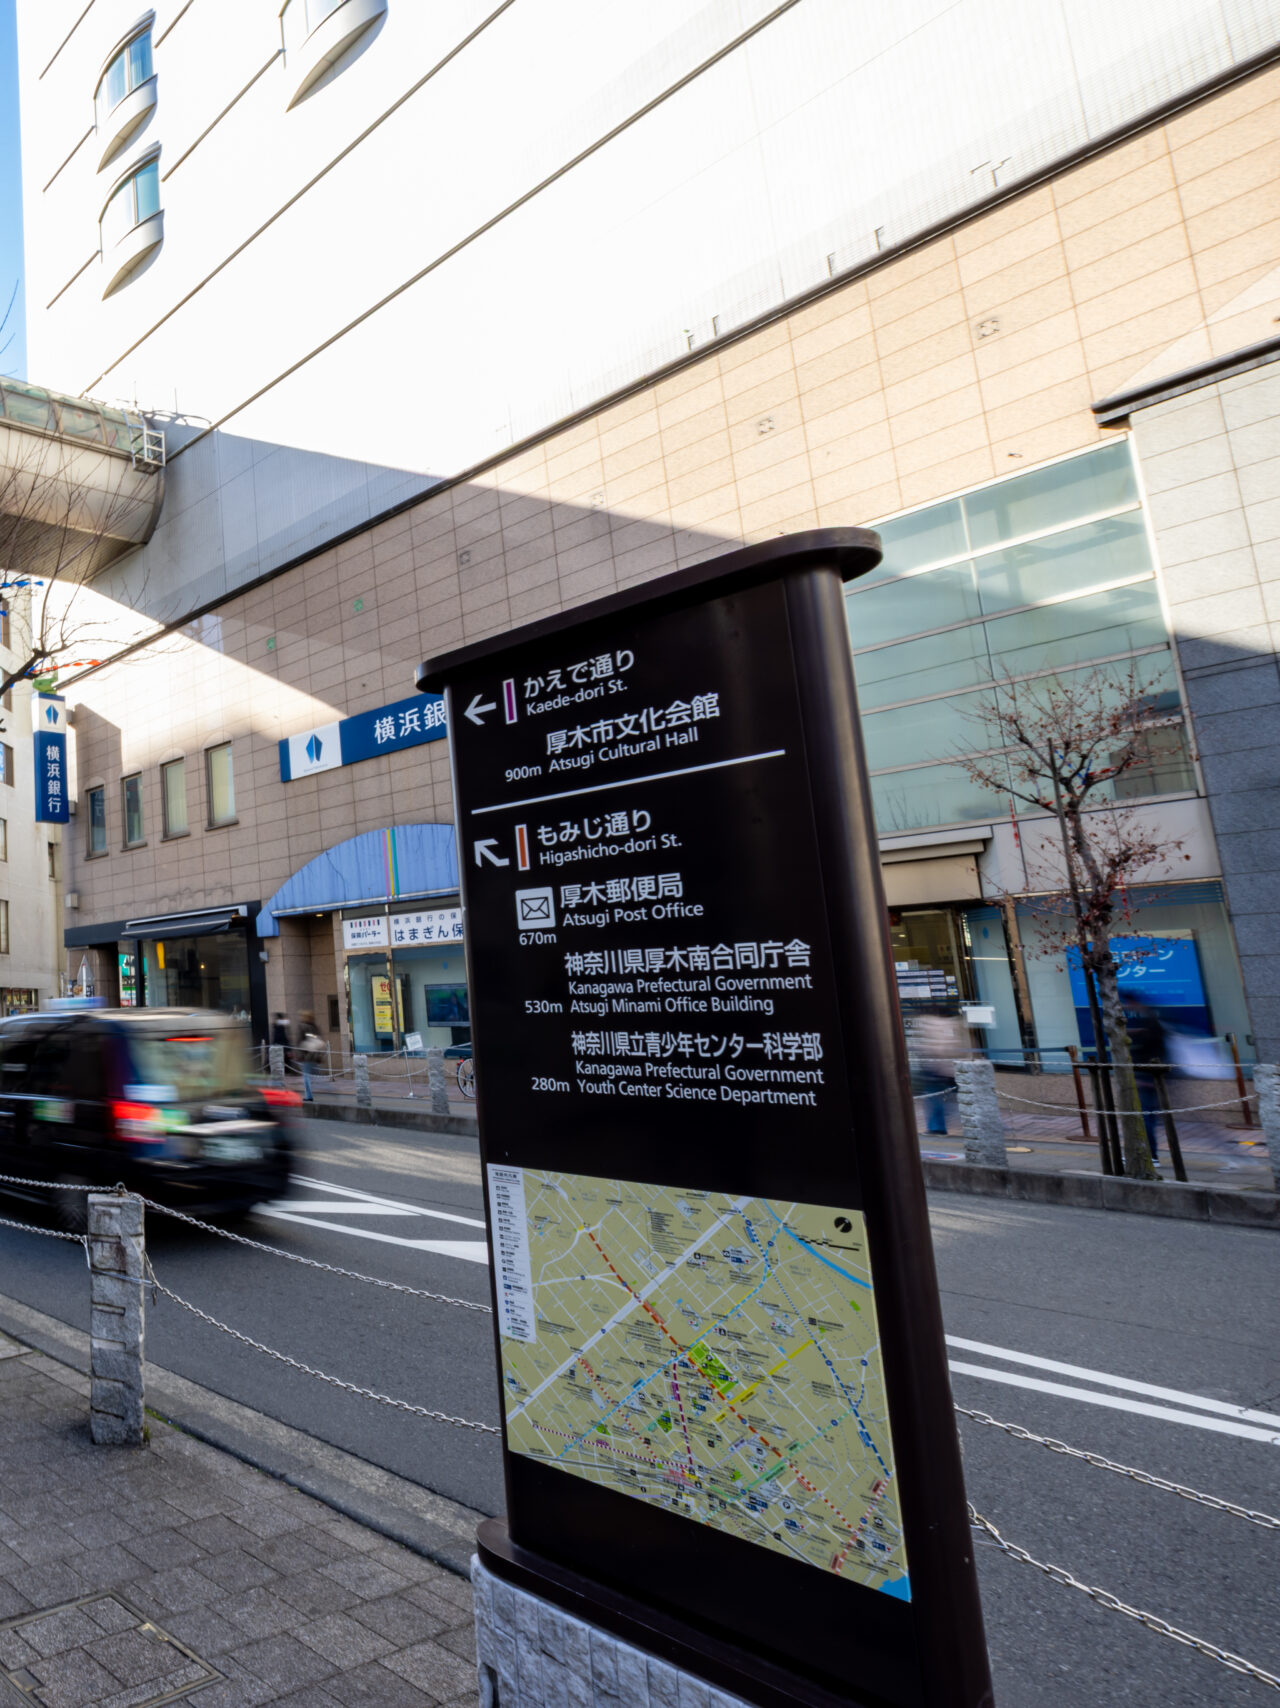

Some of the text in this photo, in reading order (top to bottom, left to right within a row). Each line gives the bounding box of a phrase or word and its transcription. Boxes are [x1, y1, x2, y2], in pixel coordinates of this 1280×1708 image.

[523, 650, 635, 699] かえで通り
[526, 679, 628, 716] Kaede-dori St.
[373, 699, 448, 745] 横浜銀
[546, 692, 721, 756] 厚木市文化会館
[505, 726, 699, 782] 900m Atsugi Cultural Hall
[46, 745, 61, 813] 横浜銀行
[537, 809, 651, 847] もみじ通り
[539, 834, 683, 867] Higashicho-dori St.
[560, 872, 683, 909] 厚木郵便局
[562, 901, 704, 928] Atsugi Post Office
[519, 931, 557, 946] 670m
[564, 938, 811, 977] 神奈川県厚木南合同庁舎
[568, 973, 813, 998] Kanagawa Prefectural Government
[525, 995, 774, 1017] 530m Atsugi Minami Office Building
[570, 1030, 824, 1062] 神奈川県立青少年センター科学部
[575, 1060, 825, 1084] Kanagawa Prefectural Government
[531, 1077, 817, 1106] 280m Youth Center Science Department
